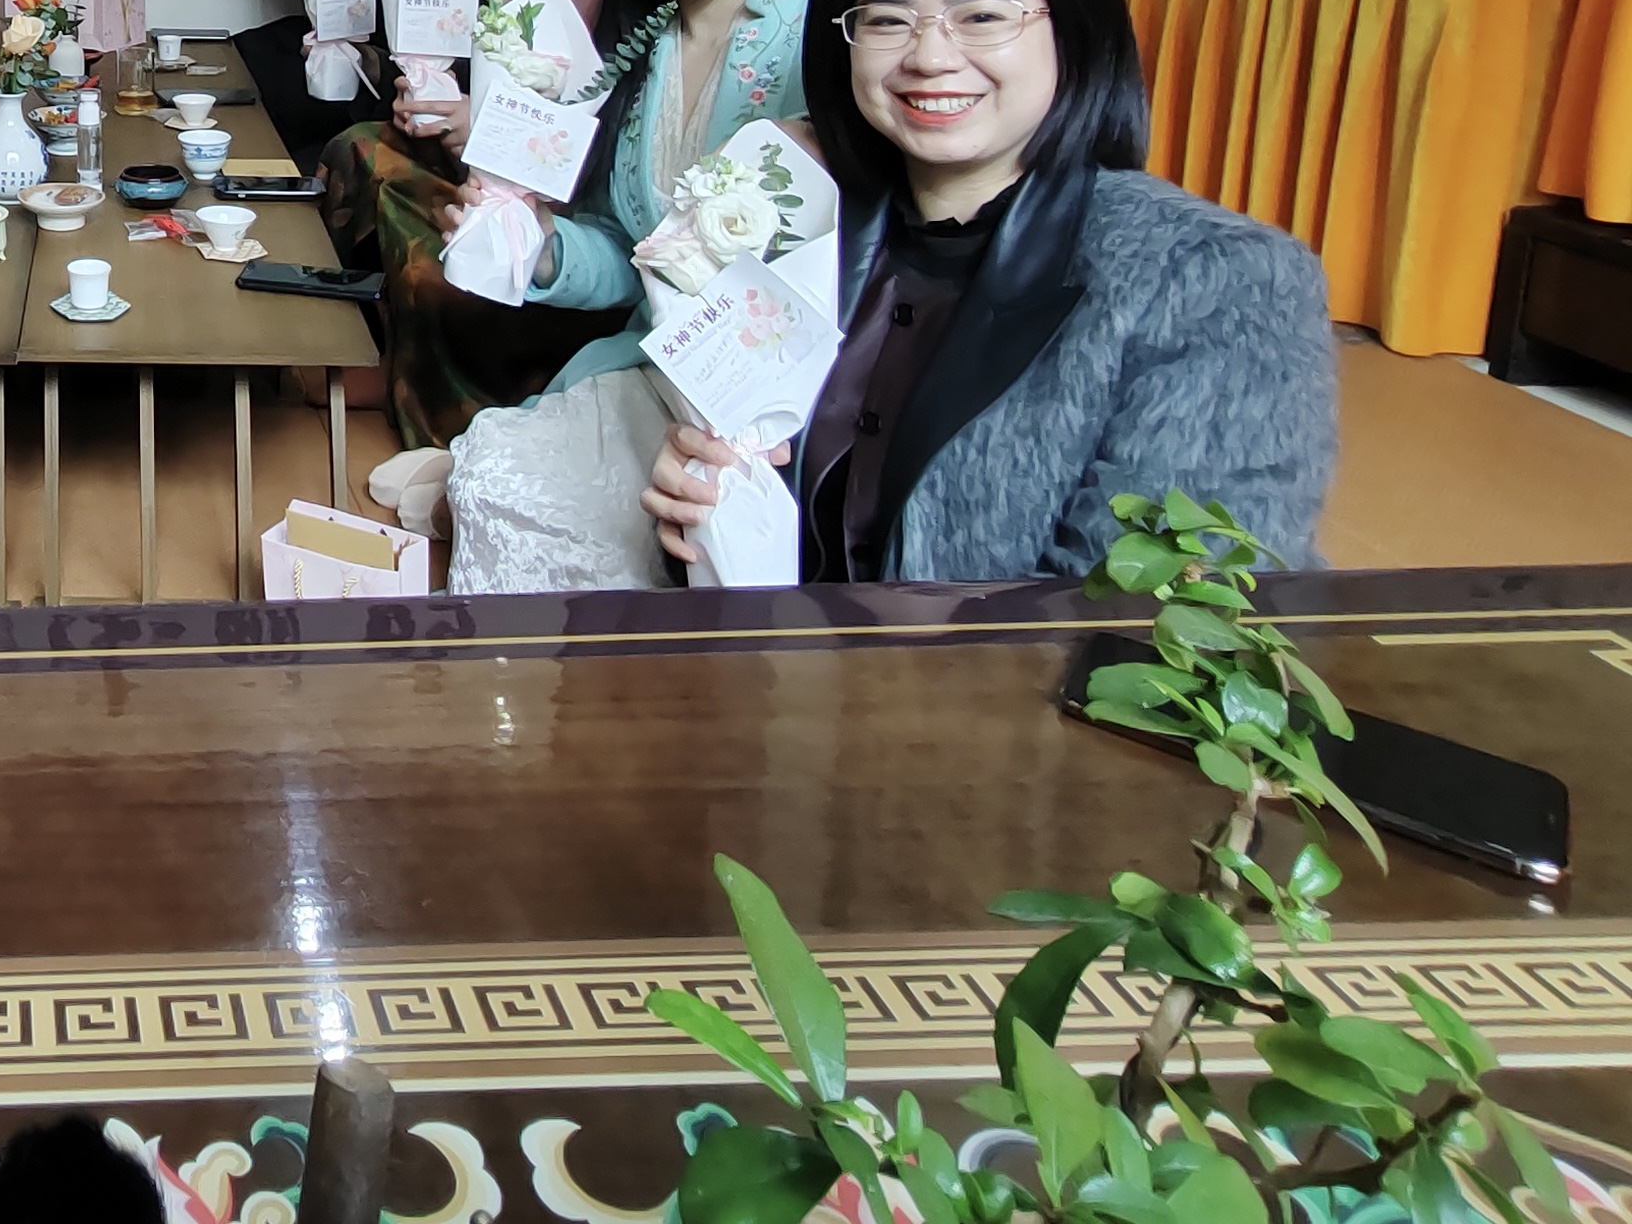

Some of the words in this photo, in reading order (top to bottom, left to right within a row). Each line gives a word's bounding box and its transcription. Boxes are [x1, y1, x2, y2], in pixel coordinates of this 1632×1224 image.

[493, 94, 555, 125] 女神节快乐
[662, 293, 734, 359] 女神节快乐
